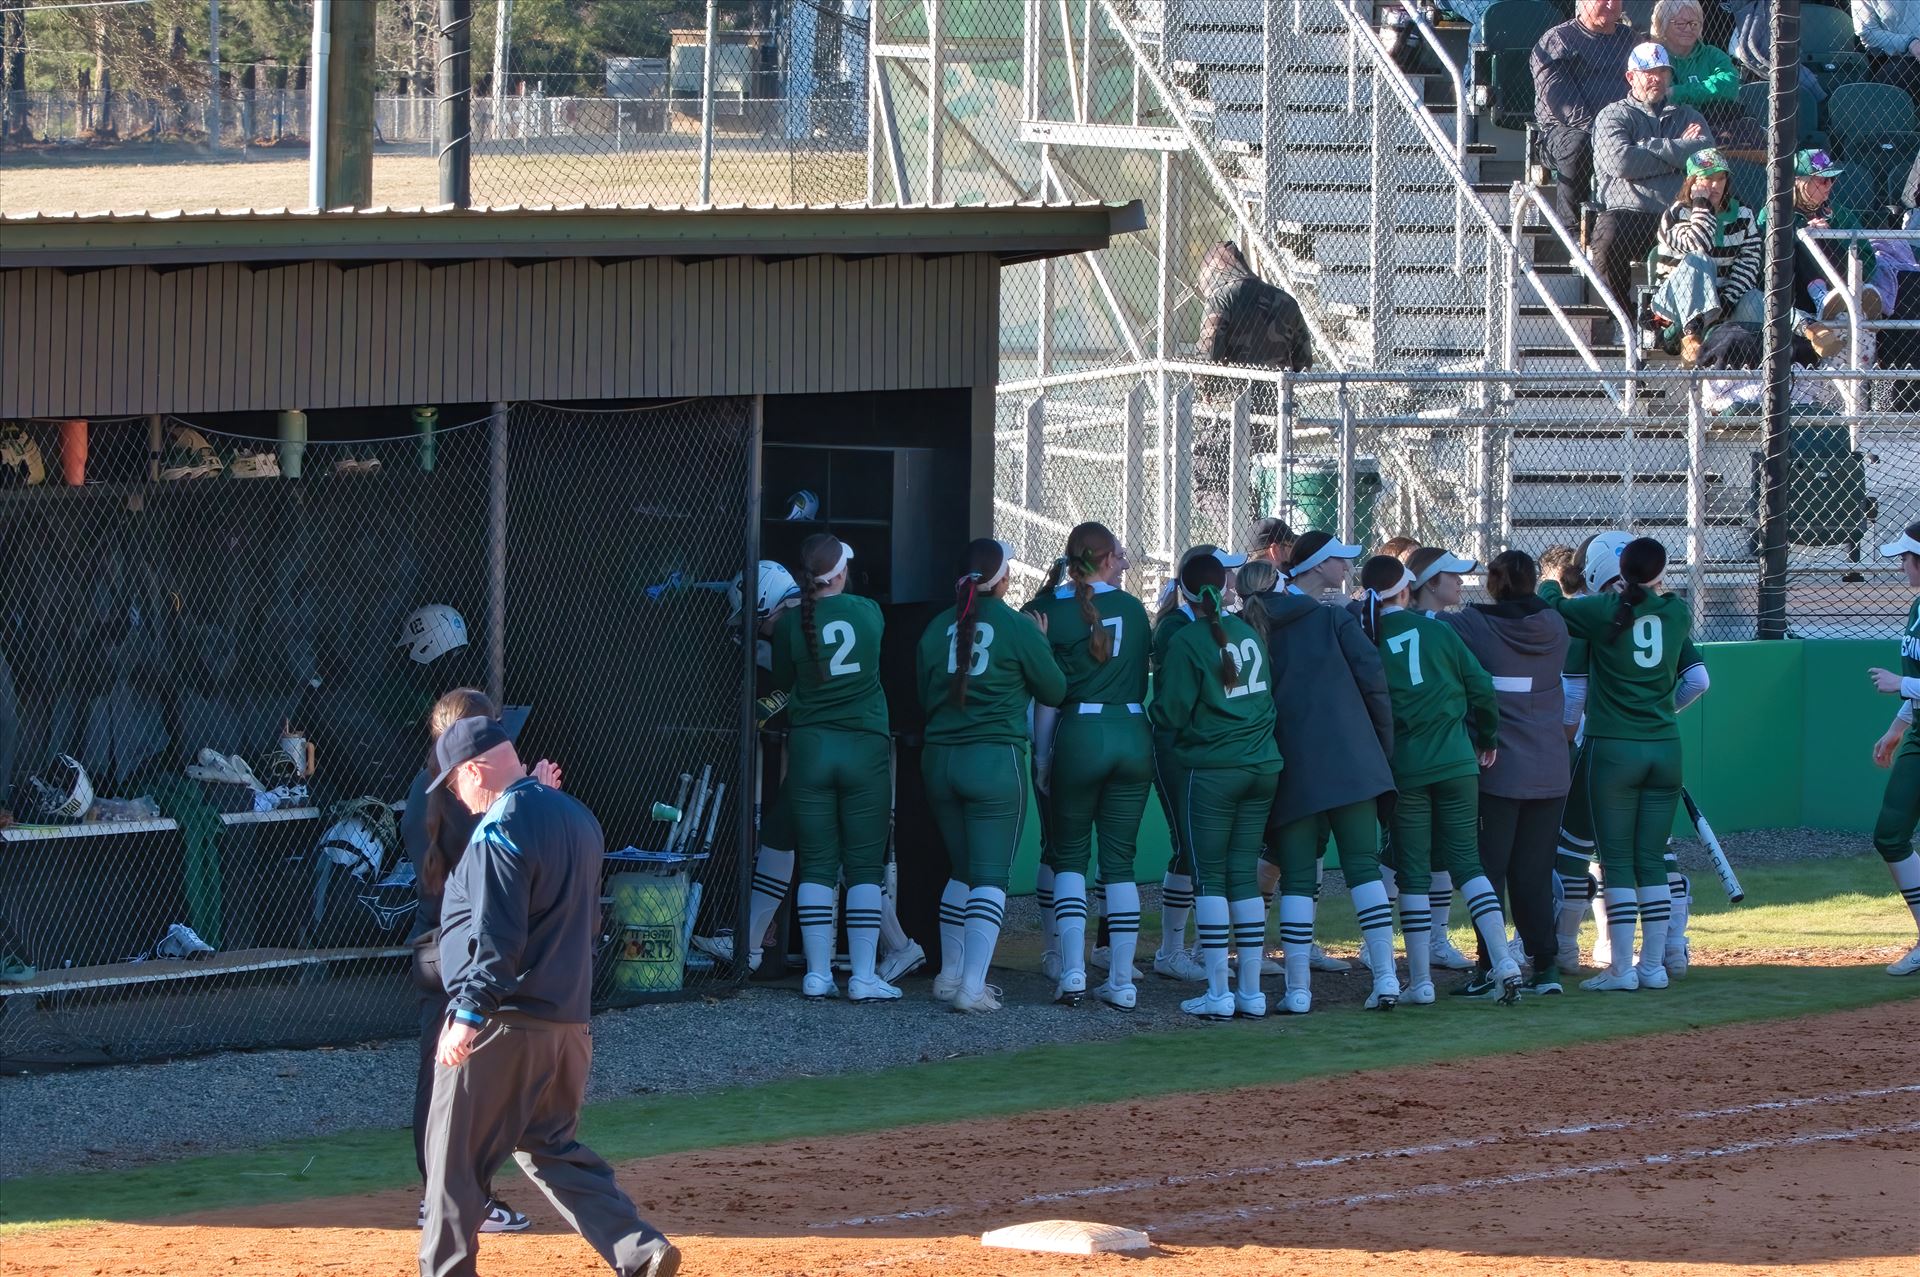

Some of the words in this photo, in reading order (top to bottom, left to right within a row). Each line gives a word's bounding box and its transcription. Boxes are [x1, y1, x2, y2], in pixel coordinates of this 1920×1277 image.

[822, 620, 861, 676] 2
[1091, 616, 1123, 658] 7
[1386, 627, 1424, 686] 7
[1633, 615, 1663, 668] 9
[1219, 638, 1267, 698] 22
